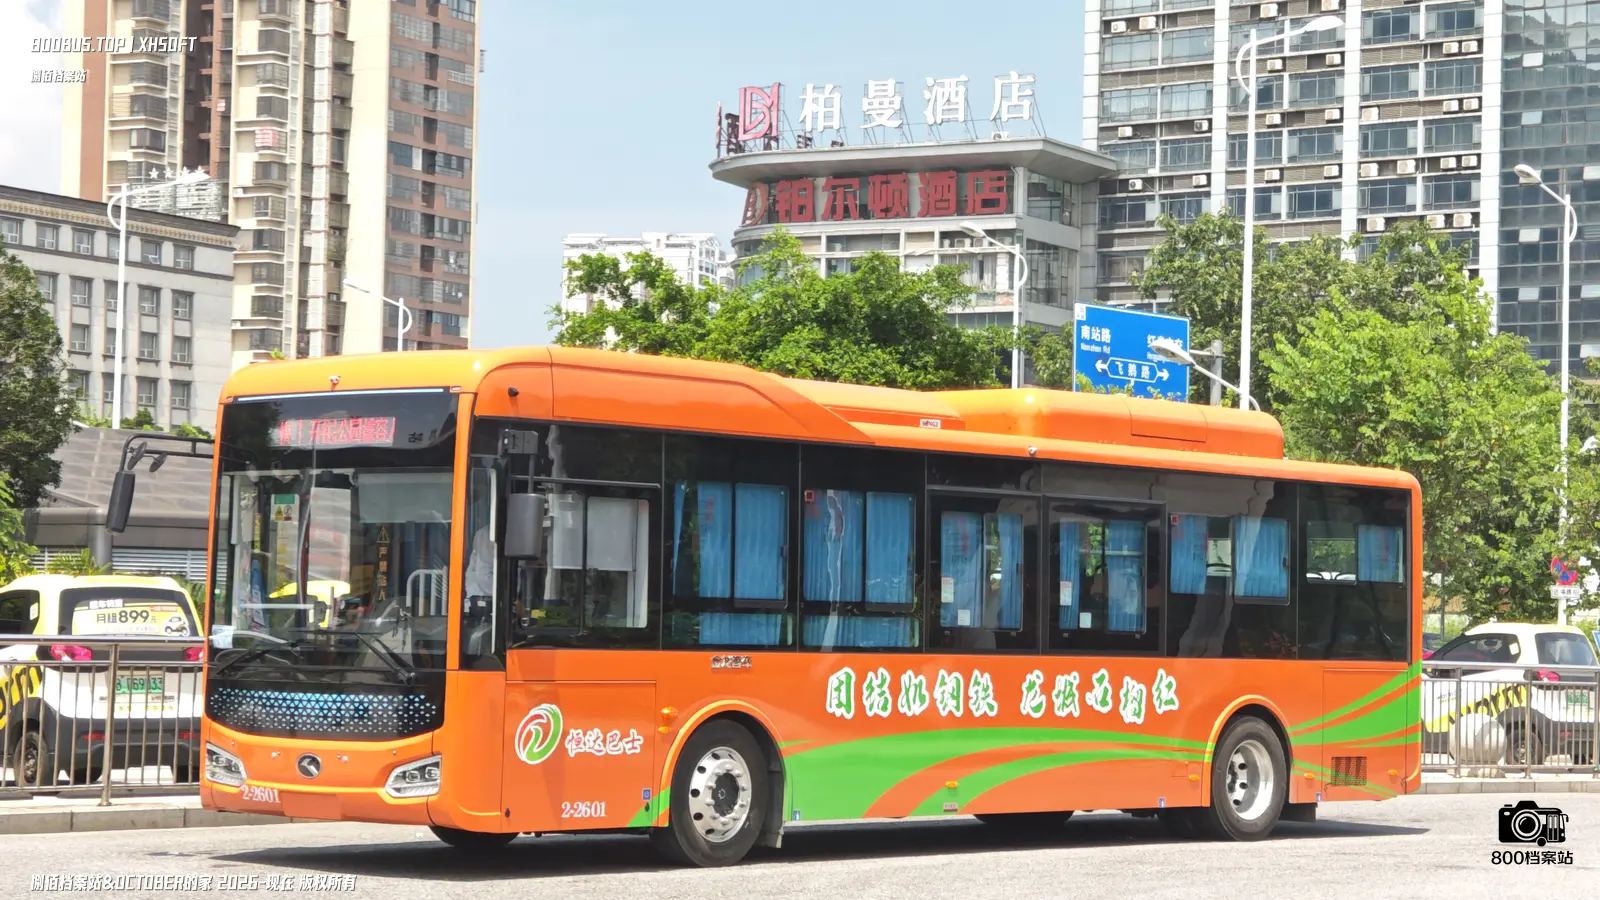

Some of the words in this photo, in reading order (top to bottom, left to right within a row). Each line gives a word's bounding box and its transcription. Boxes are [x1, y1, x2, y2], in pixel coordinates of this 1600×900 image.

[798, 71, 1036, 132] 柏曼酒店
[776, 168, 1008, 223] 铂尔顿酒店
[1080, 325, 1111, 344] 南站路
[565, 729, 644, 758] 恒达巴士
[241, 785, 281, 804] 2-2601
[561, 802, 607, 818] 2-2601
